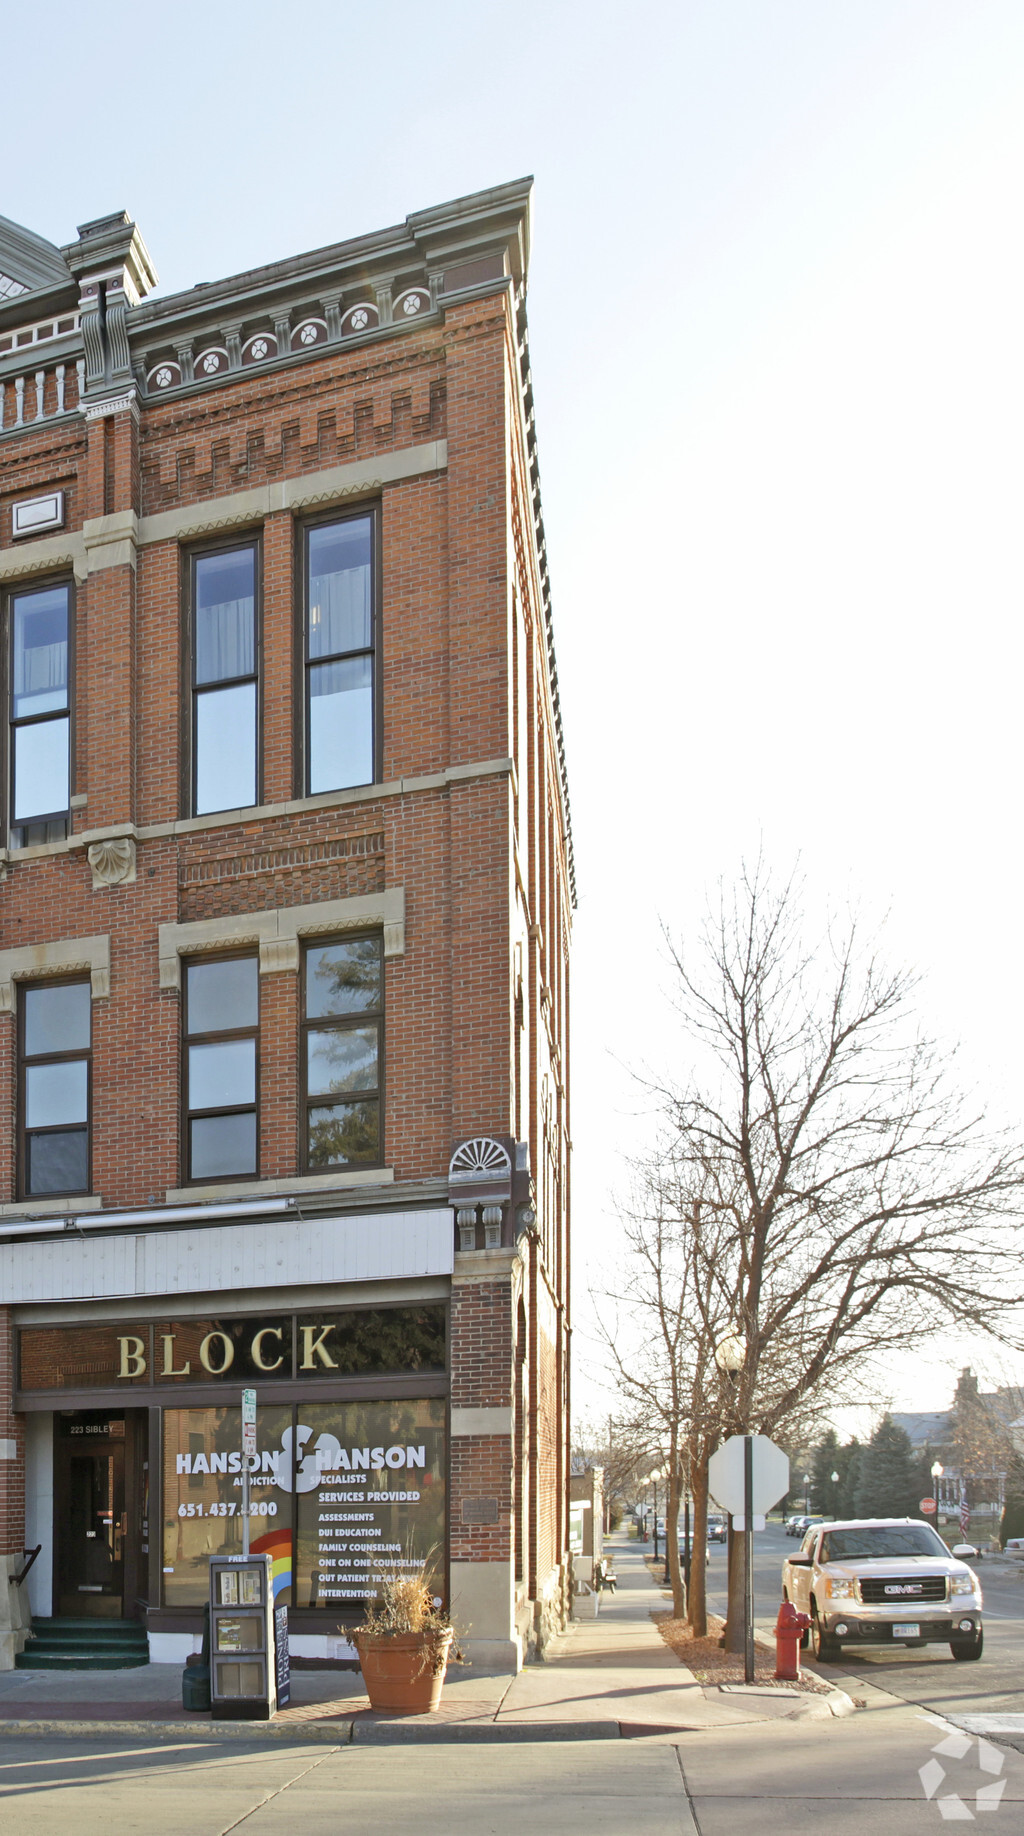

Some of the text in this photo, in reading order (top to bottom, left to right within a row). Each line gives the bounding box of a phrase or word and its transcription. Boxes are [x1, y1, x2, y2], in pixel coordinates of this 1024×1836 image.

[117, 1325, 339, 1378] BLOCK
[70, 1425, 114, 1434] 223 SIBLEY
[176, 1450, 279, 1474] HANSON
[316, 1445, 425, 1471] HANSON
[233, 1474, 367, 1486] ADICTION SPECIALISTS
[318, 1491, 420, 1502] SERVICES PROVIDED
[178, 1501, 278, 1517] 651.437.200
[318, 1513, 374, 1522] ASSESSMENTS
[318, 1528, 381, 1537] DUI EDUCATION
[318, 1543, 401, 1552] FAMILY COUNSELING
[228, 1555, 248, 1563] FREE
[318, 1559, 426, 1567] ONE ON ONE COUNSELING
[318, 1574, 335, 1582] OUT
[337, 1574, 370, 1582] PATIENT
[318, 1589, 377, 1598] INTERVENTION
[884, 1584, 923, 1594] GMC
